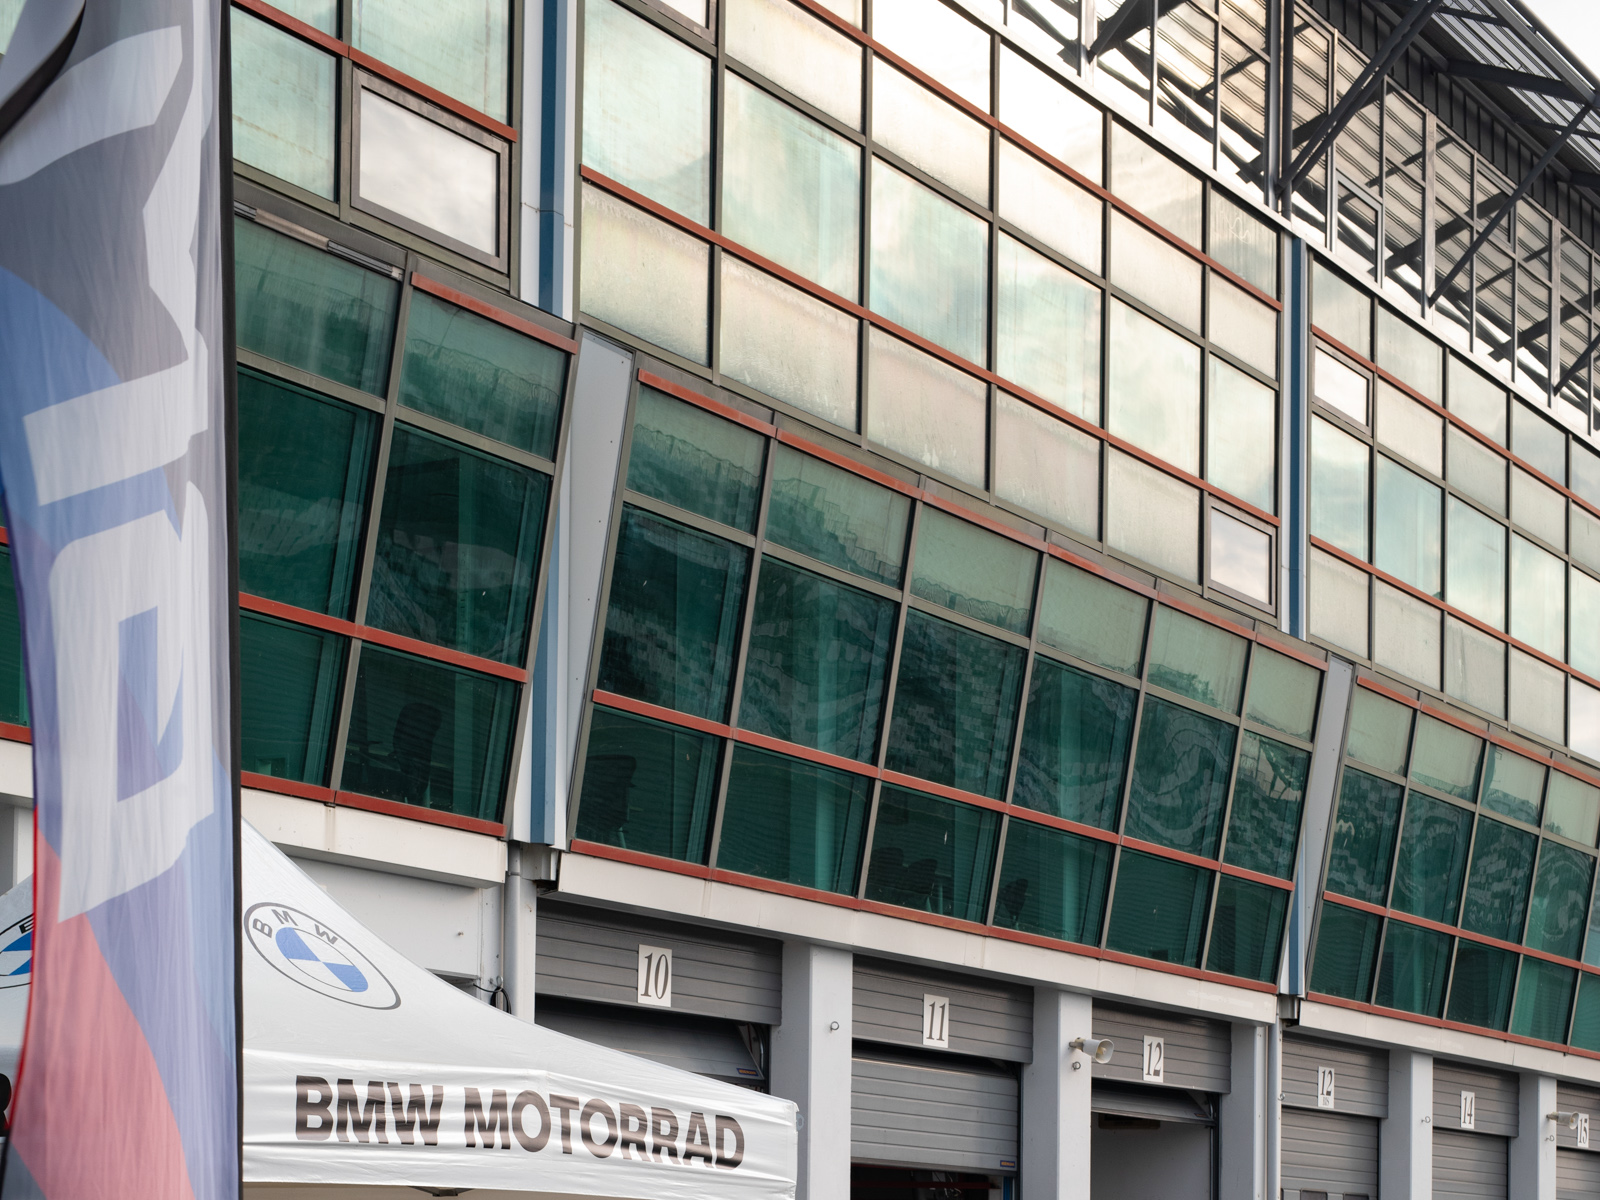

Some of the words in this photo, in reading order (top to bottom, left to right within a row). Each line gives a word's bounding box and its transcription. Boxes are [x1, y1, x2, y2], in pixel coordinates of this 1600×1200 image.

[252, 908, 339, 945] BMW
[640, 952, 669, 1000] 10
[926, 1001, 946, 1042] 11
[1147, 1041, 1163, 1077] 12
[1320, 1069, 1333, 1097] 12
[295, 1074, 444, 1146] BMW
[463, 1087, 745, 1171] MOTORRAD
[1463, 1096, 1475, 1125] 14
[1578, 1117, 1588, 1145] 15
